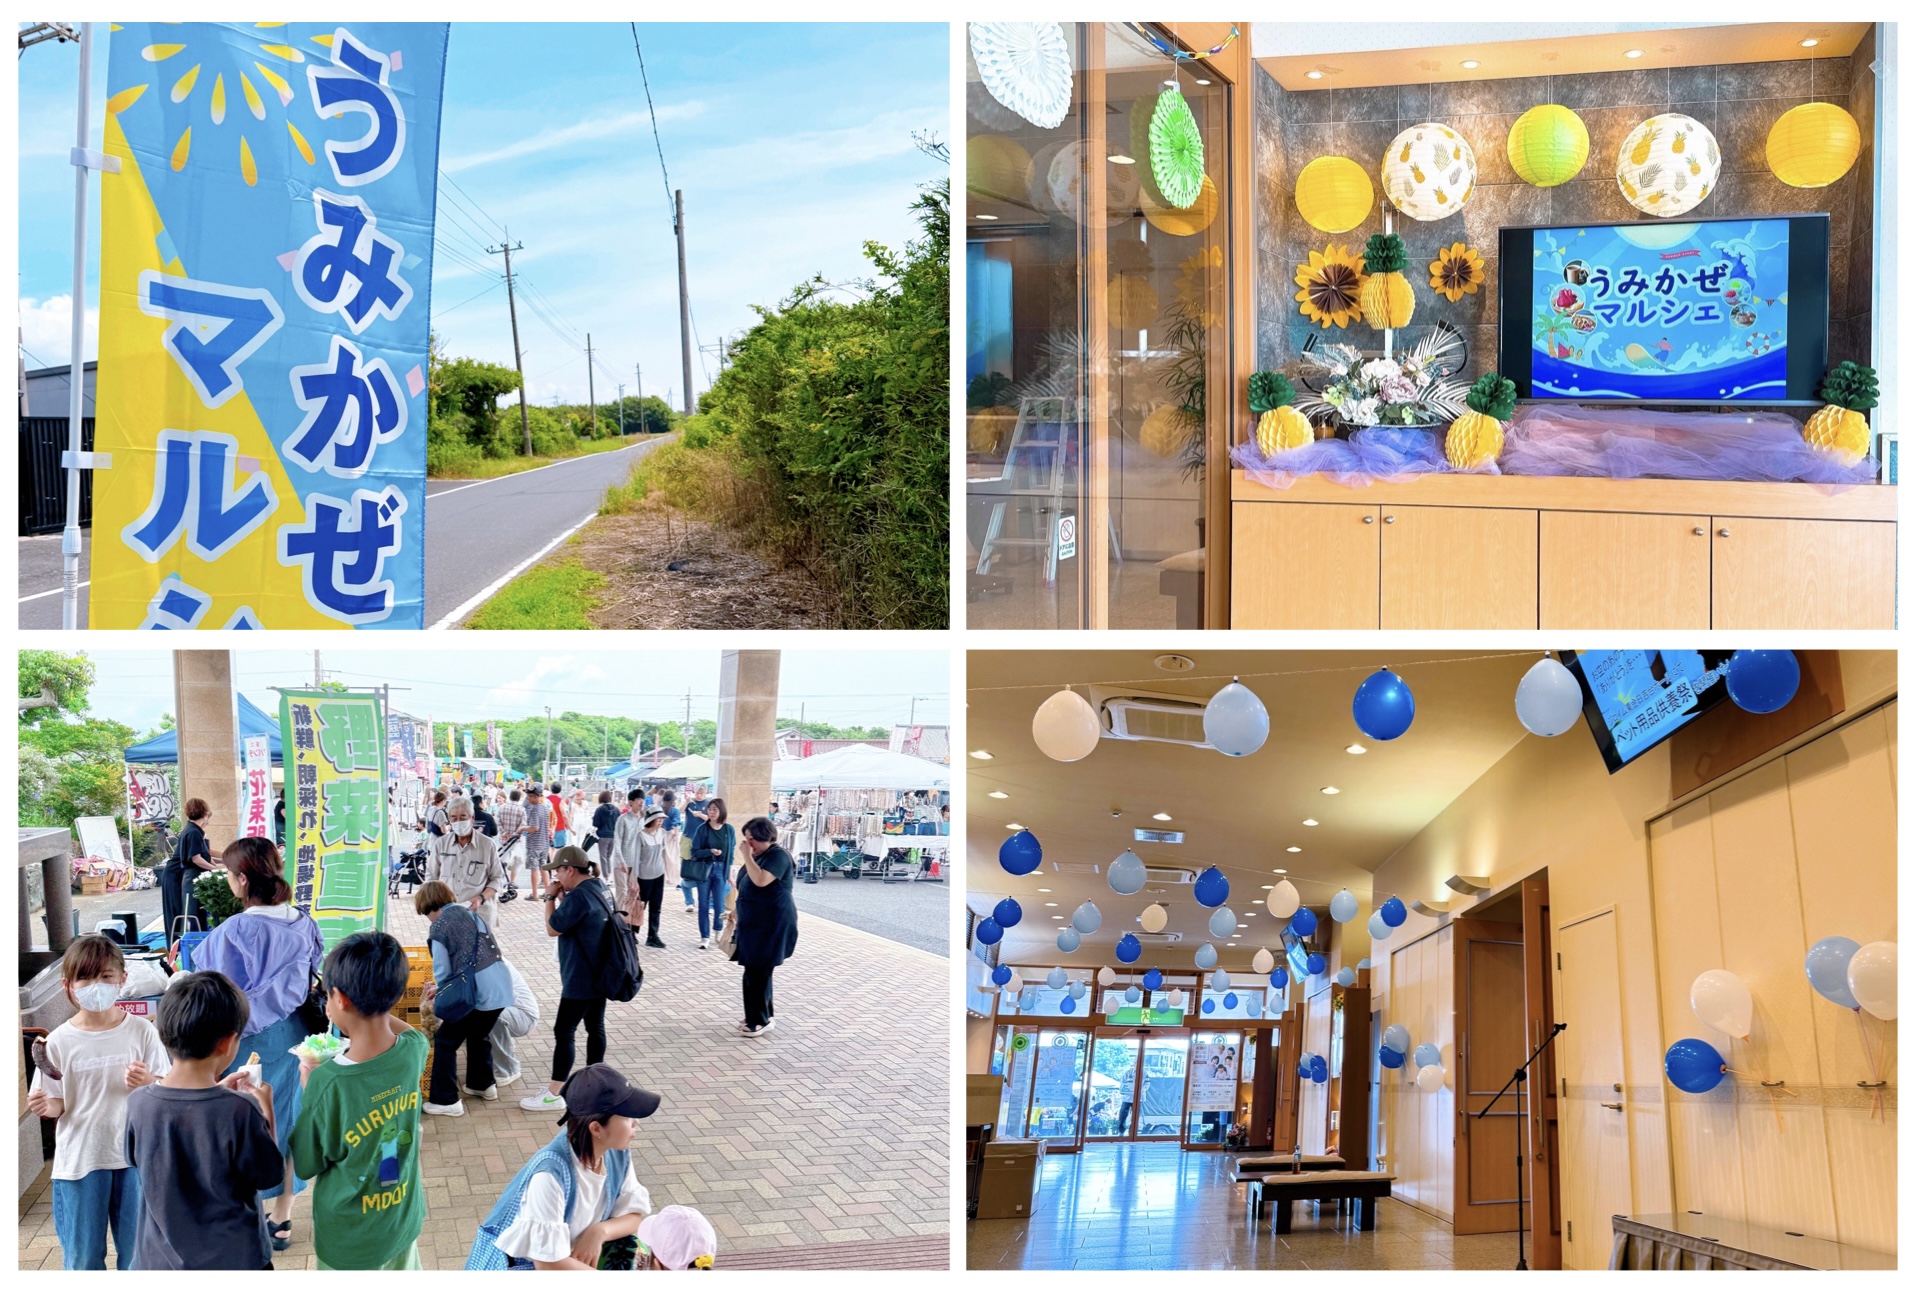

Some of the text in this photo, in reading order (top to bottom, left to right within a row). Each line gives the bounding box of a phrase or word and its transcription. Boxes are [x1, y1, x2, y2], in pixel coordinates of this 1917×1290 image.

[1590, 263, 1728, 297] うみかぜ
[281, 31, 410, 621] うみかぜ
[1594, 300, 1721, 326] マルシェ
[1616, 681, 1694, 743] ペット用品供養祭
